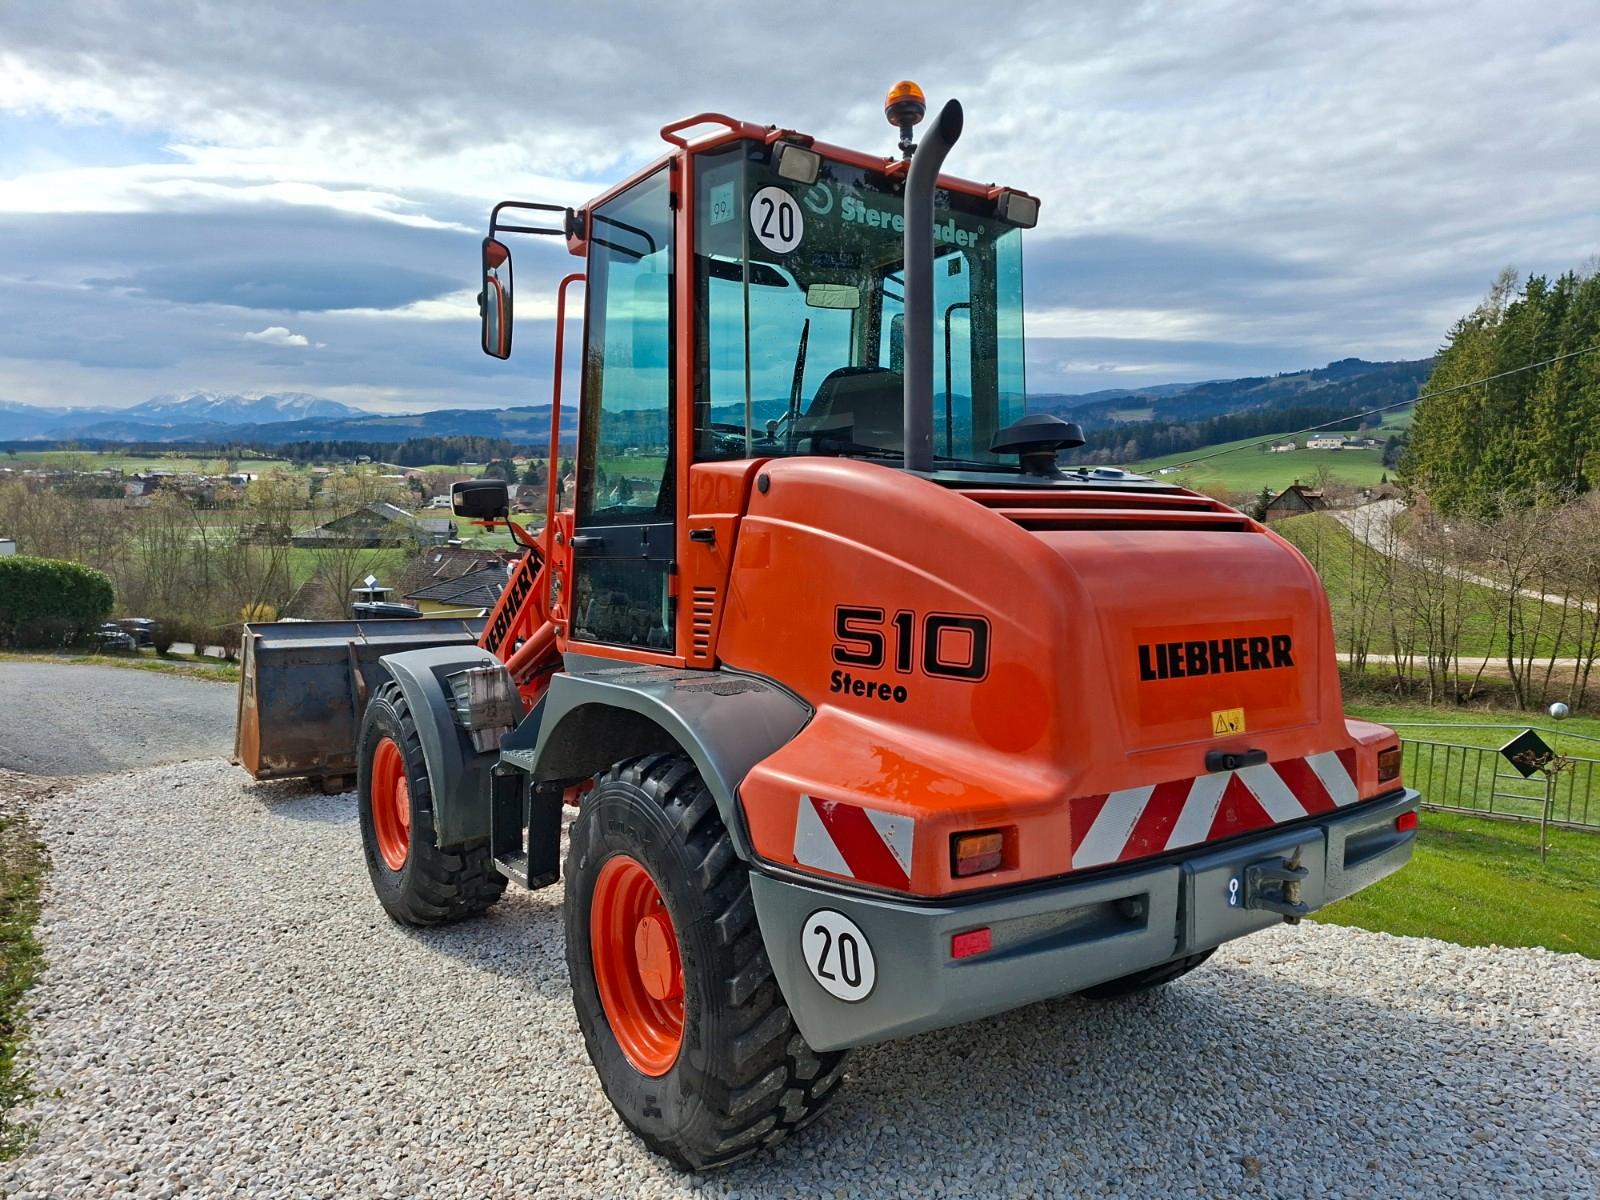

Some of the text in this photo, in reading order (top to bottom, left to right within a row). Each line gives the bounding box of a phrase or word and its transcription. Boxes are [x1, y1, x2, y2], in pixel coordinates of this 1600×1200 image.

[760, 197, 794, 243] 20
[483, 548, 545, 654] IEBHERR
[831, 604, 992, 683] 510
[1138, 634, 1295, 682] LIEBHERR
[830, 670, 908, 703] Stereo
[813, 925, 862, 988] 20
